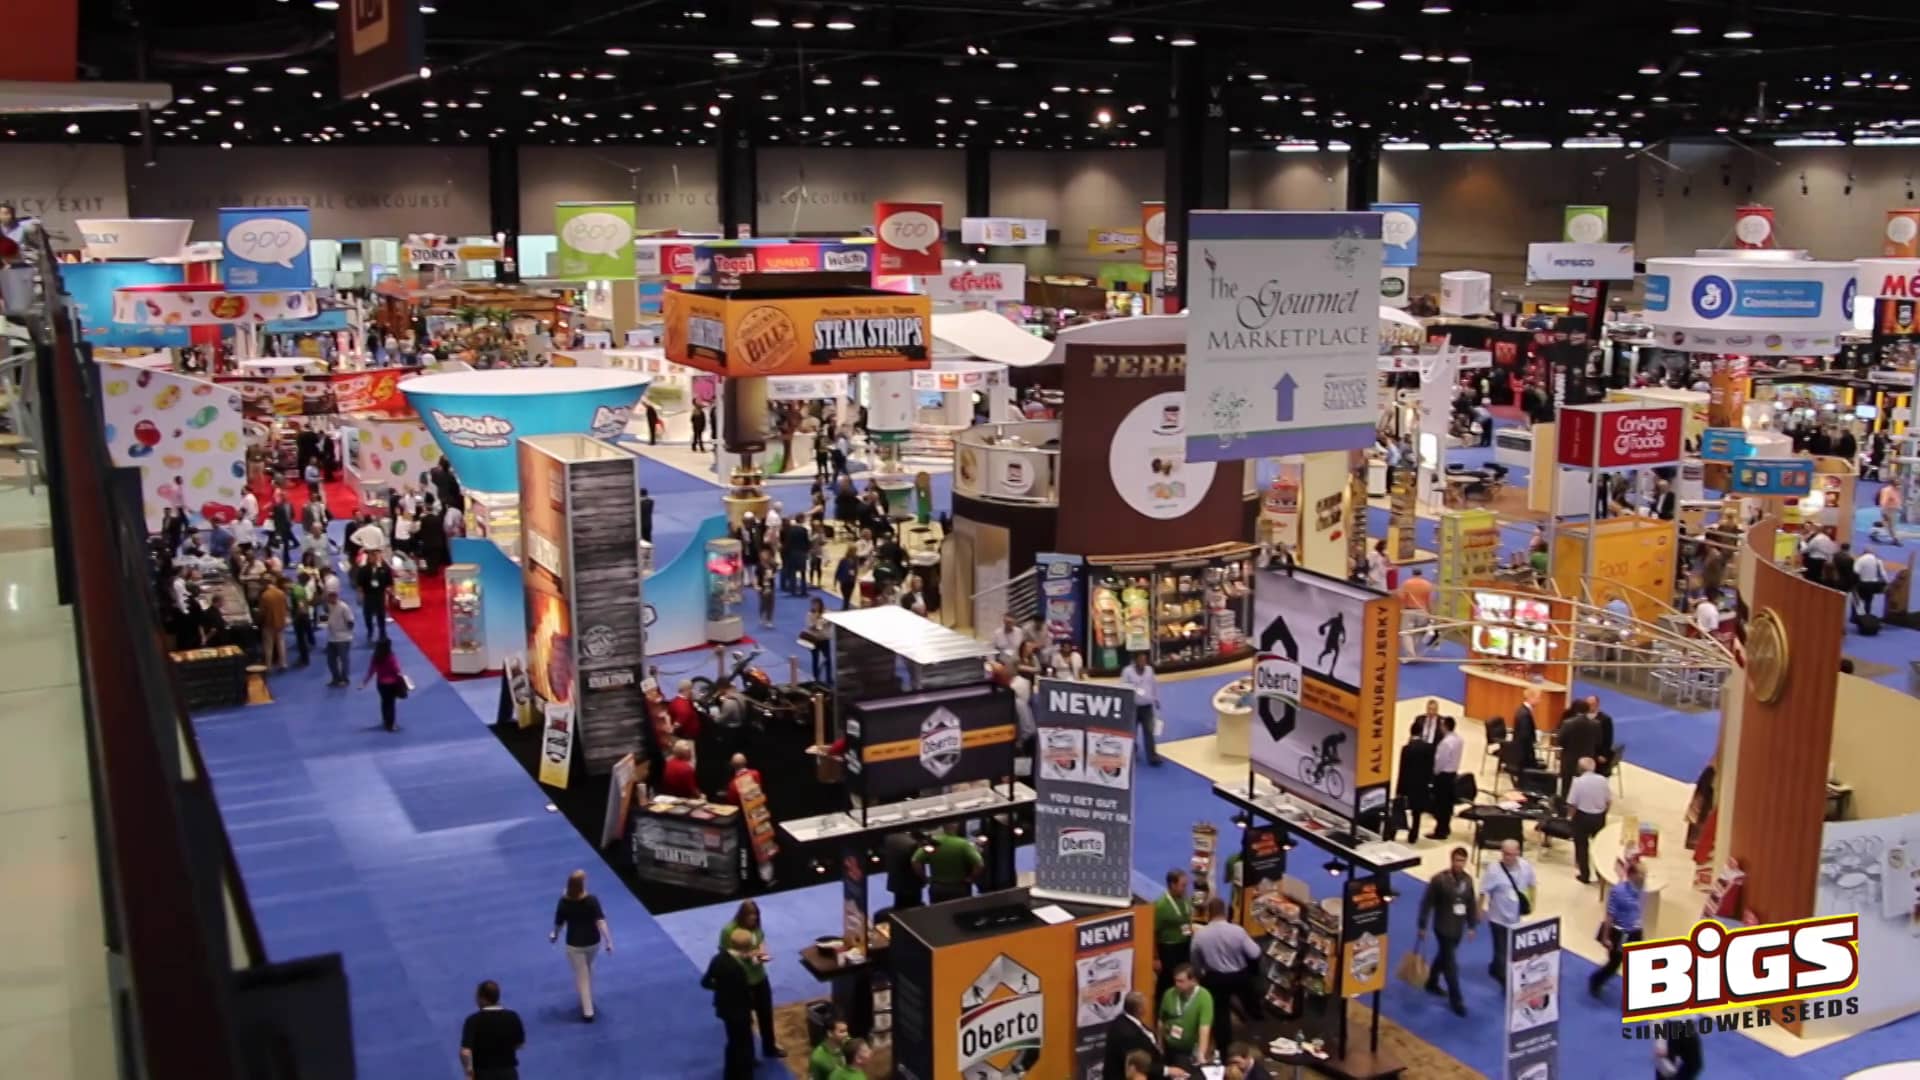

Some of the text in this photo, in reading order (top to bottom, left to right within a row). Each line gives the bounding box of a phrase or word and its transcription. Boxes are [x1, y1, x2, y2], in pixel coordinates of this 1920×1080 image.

[58, 197, 104, 213] EXIT
[679, 191, 697, 206] TO
[893, 221, 927, 238] 700
[241, 231, 291, 255] 900
[1208, 275, 1239, 300] The
[1236, 279, 1360, 331] Gourmet
[814, 317, 923, 351] STEAK STRIPS
[1207, 325, 1370, 351] MARKETPLACE
[1616, 415, 1668, 434] ConAgra
[1628, 432, 1665, 450] Foods
[1257, 666, 1299, 695] Oberto
[1370, 605, 1390, 774] ALL NATURAL JERKY
[1048, 689, 1123, 719] NEW!
[1036, 803, 1067, 816] WHAT
[1069, 807, 1090, 818] YOU
[1091, 810, 1114, 821] PUT
[1049, 792, 1118, 809] YOU GET OUT
[1061, 836, 1104, 852] Oberto
[1080, 921, 1130, 947] NEW!
[1514, 922, 1558, 950] NEW!
[962, 1010, 1039, 1057] Oberto
